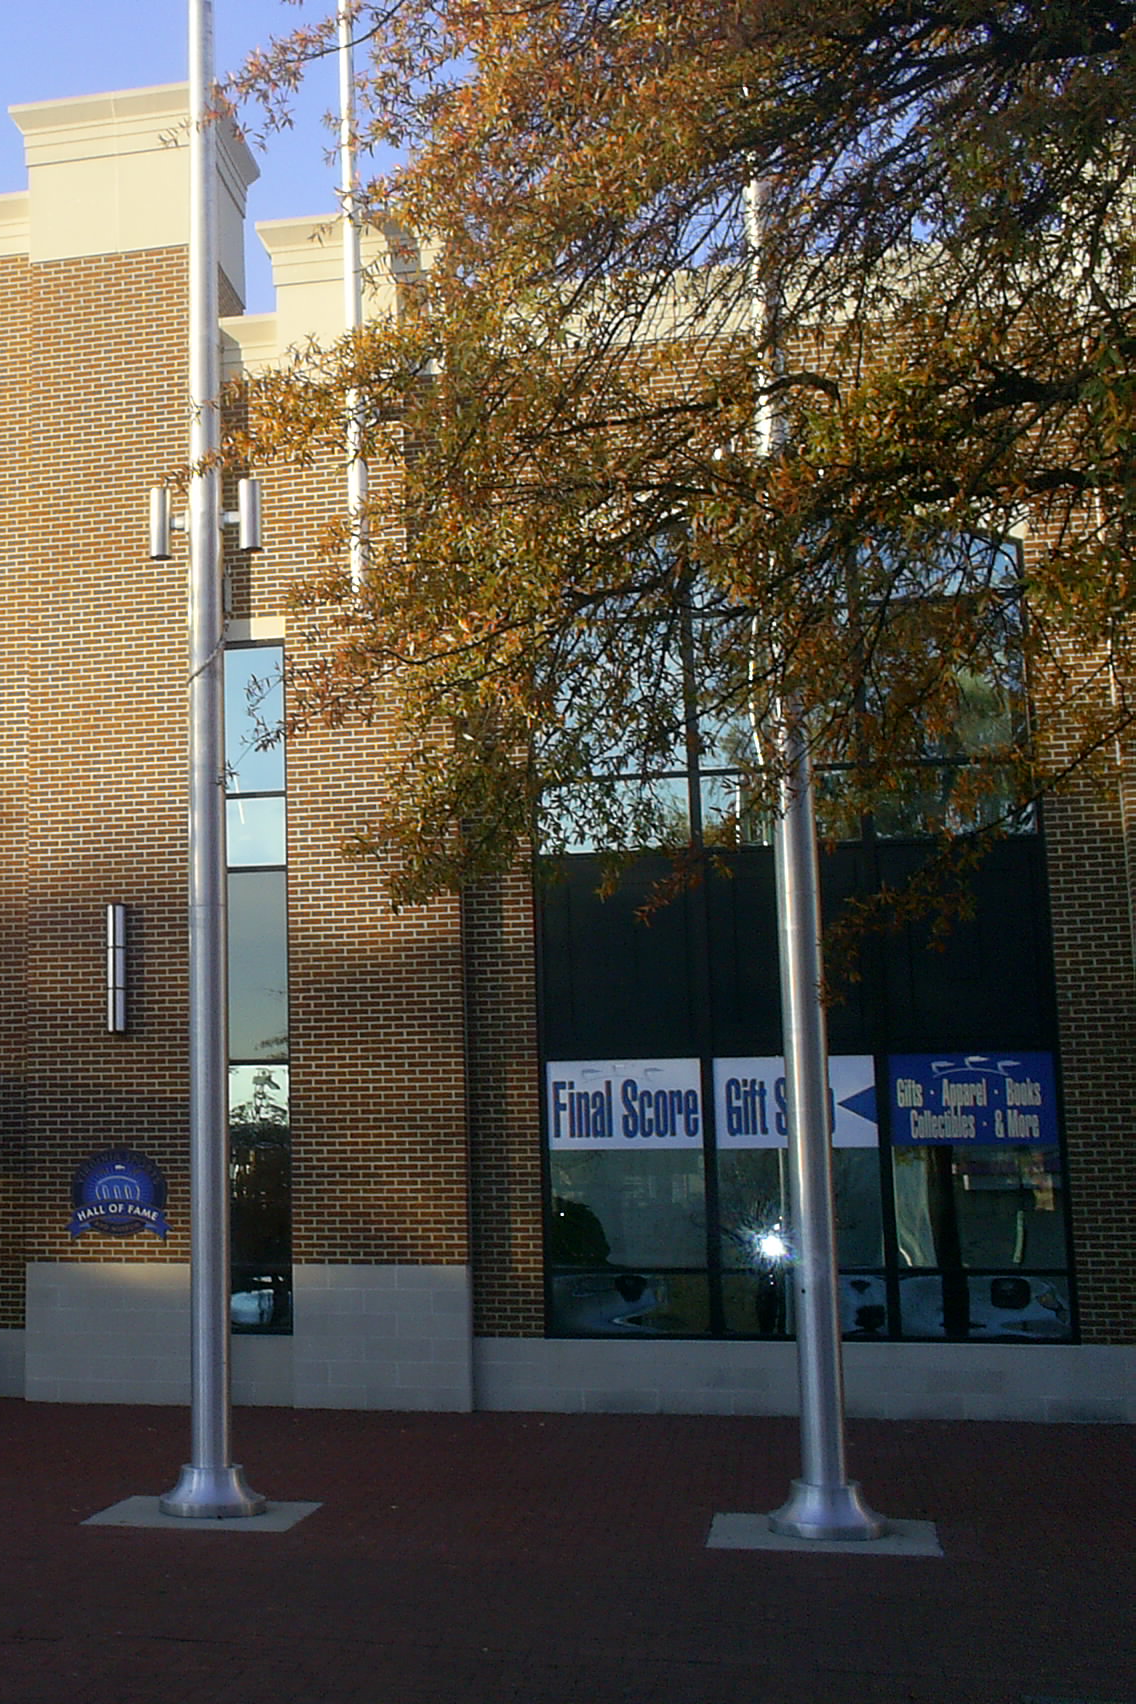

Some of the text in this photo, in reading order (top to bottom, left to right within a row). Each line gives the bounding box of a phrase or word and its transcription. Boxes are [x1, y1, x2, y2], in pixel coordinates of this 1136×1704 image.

[552, 1079, 700, 1138] Final Score
[725, 1077, 769, 1136] Gift
[896, 1077, 1042, 1111] Gifts Apparel Books
[910, 1108, 1041, 1139] Collectibles & More
[77, 1203, 159, 1221] HALL OF FAME
